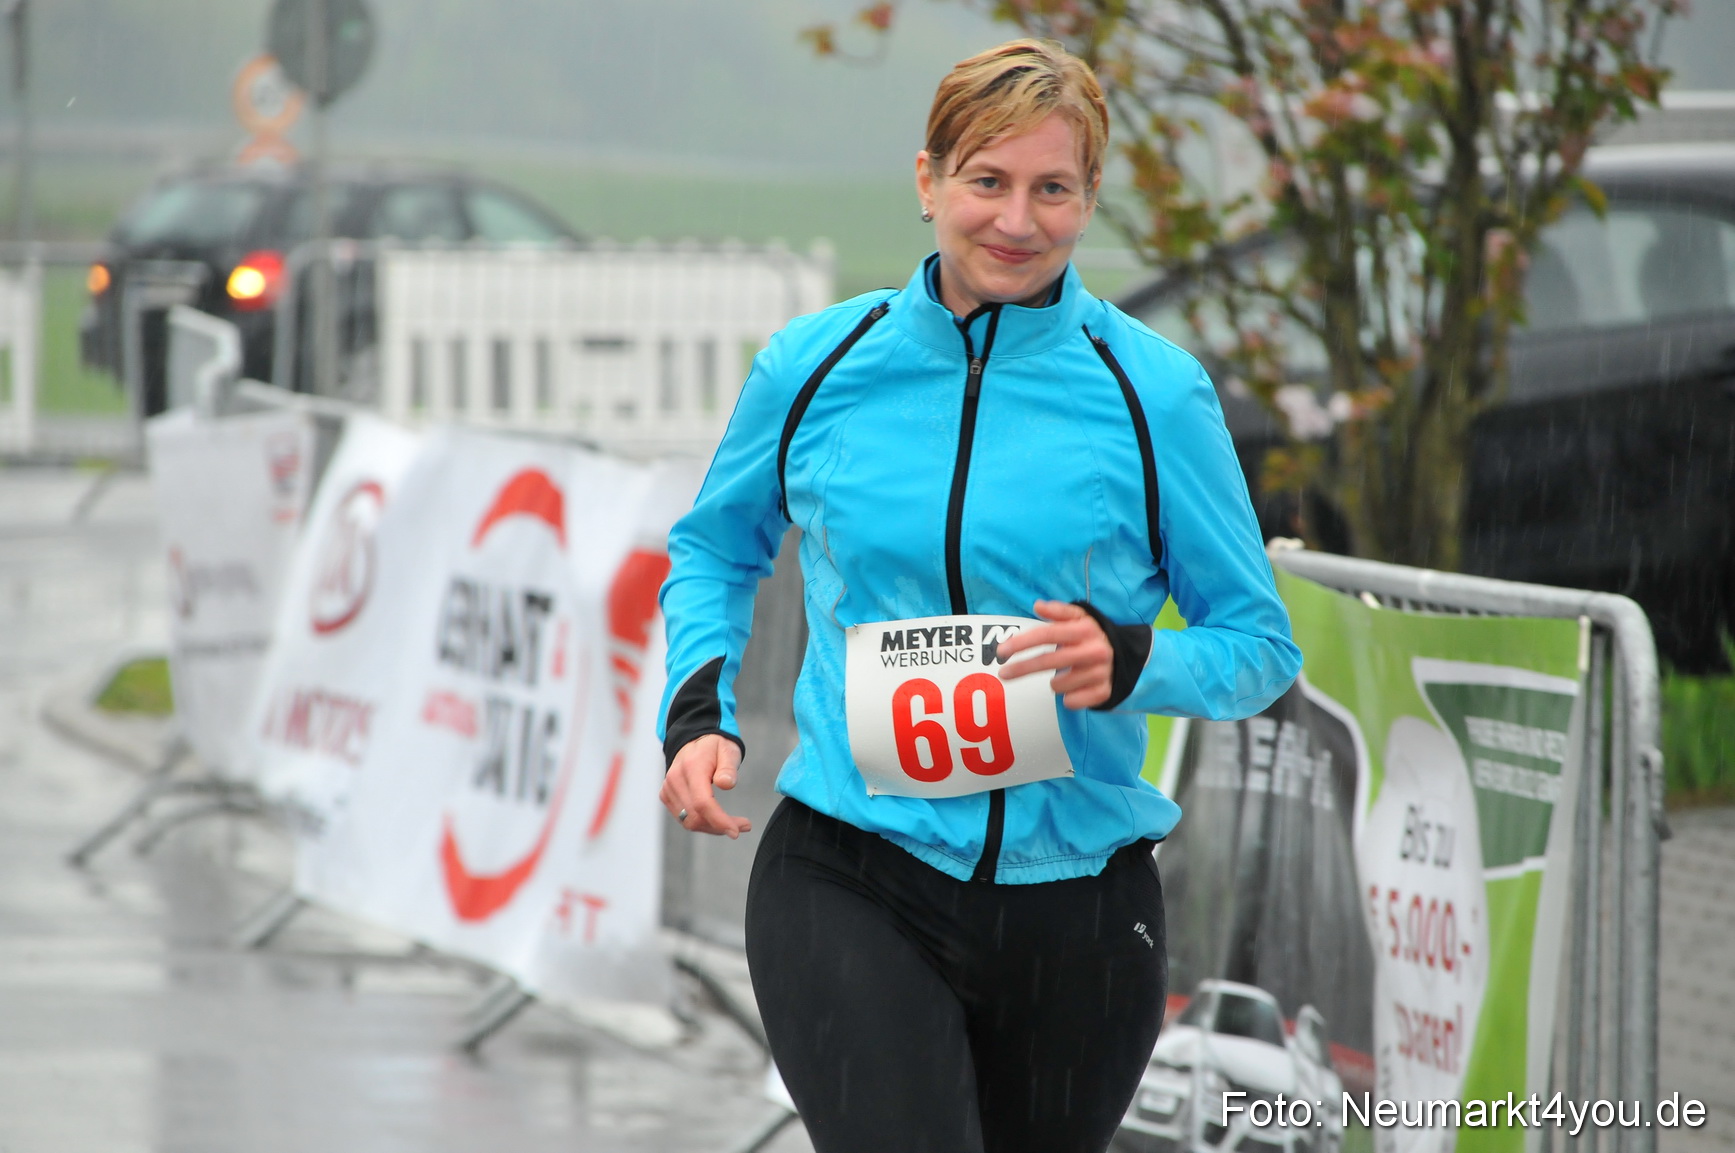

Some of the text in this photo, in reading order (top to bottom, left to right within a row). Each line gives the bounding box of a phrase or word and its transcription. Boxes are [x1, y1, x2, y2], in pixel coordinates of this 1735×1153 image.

[881, 625, 974, 652] MEYER
[880, 648, 974, 668] WERBUNG
[892, 673, 1015, 783] 69
